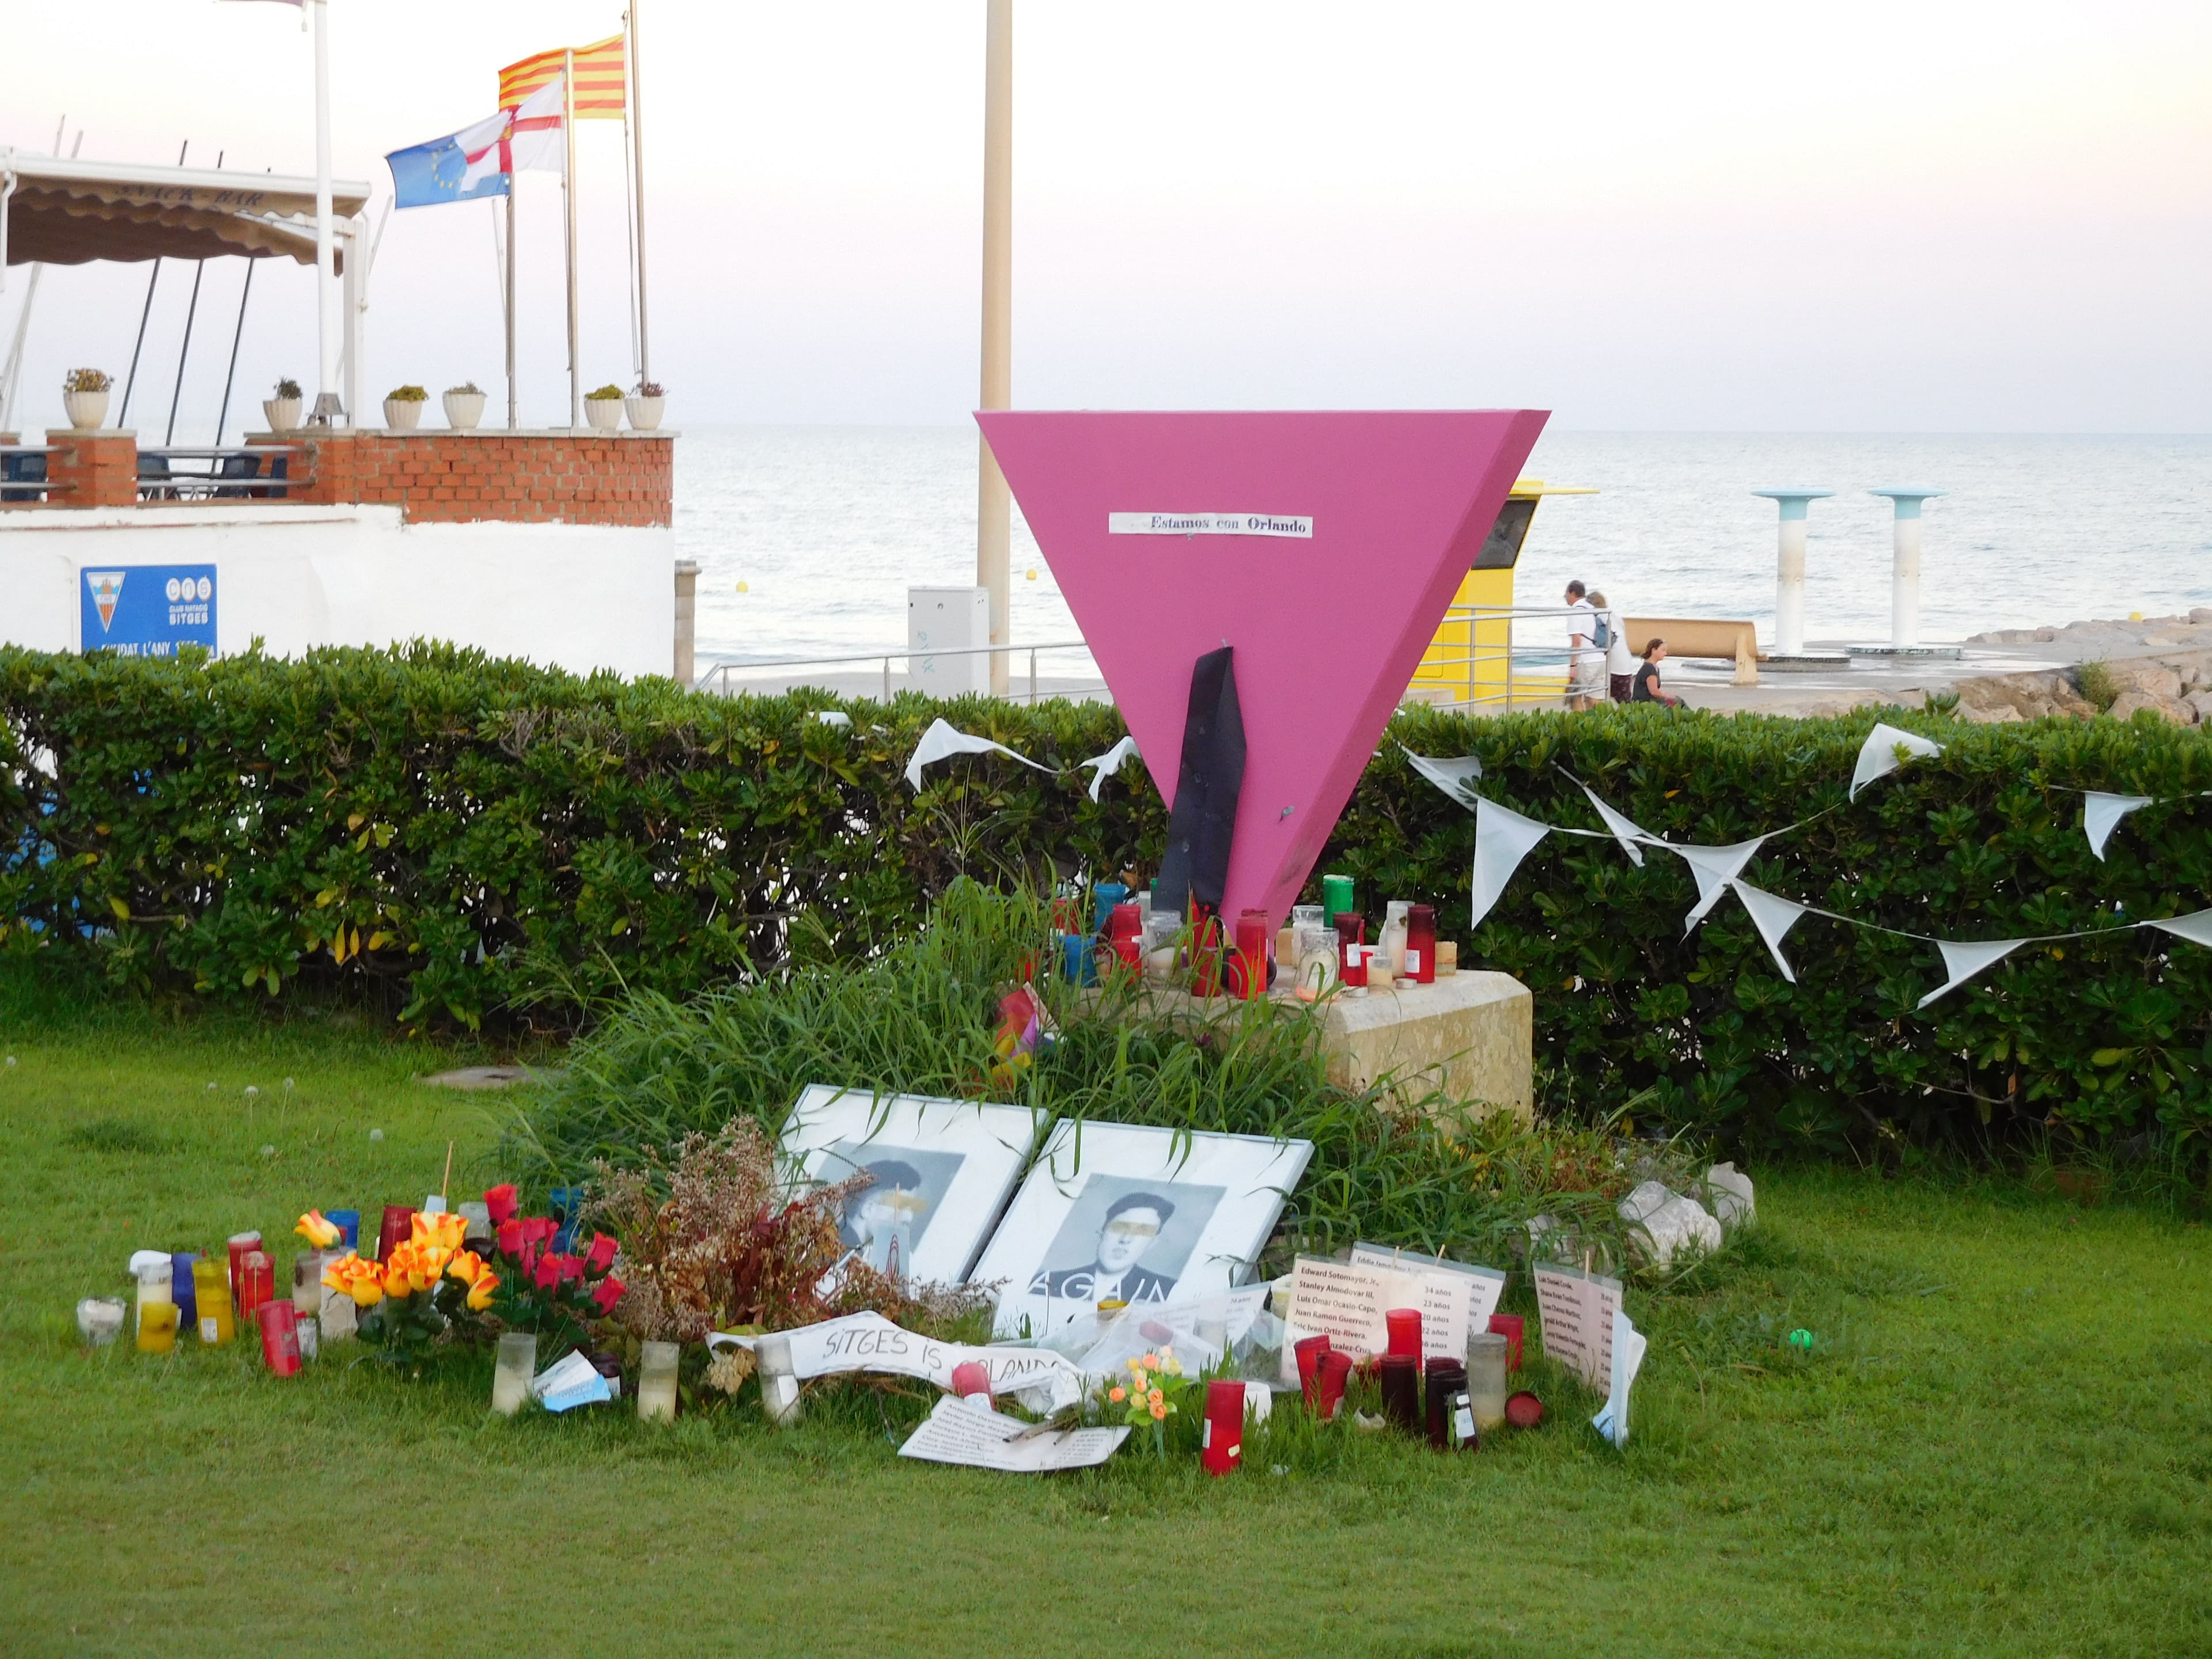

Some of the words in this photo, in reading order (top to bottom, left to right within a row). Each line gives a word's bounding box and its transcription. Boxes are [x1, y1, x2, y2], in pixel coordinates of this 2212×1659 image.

[1152, 516, 1209, 529] Estamos
[1217, 520, 1239, 529] con
[1248, 517, 1306, 533] Orlando
[1301, 1267, 1327, 1278] Edward
[1328, 1270, 1368, 1284] Sotomayor,
[1299, 1280, 1325, 1292] Stanley
[1325, 1285, 1364, 1297] Almodovar
[1435, 1288, 1452, 1297] años
[1297, 1294, 1310, 1303] Luis
[1312, 1297, 1331, 1306] Omar
[1423, 1299, 1432, 1308] 23
[1295, 1308, 1311, 1317] Juan
[1339, 1315, 1372, 1327] Guerrero,
[1432, 1315, 1449, 1323] años
[1307, 1324, 1323, 1333] Ivan
[1431, 1328, 1448, 1336] años
[1430, 1341, 1447, 1349] años
